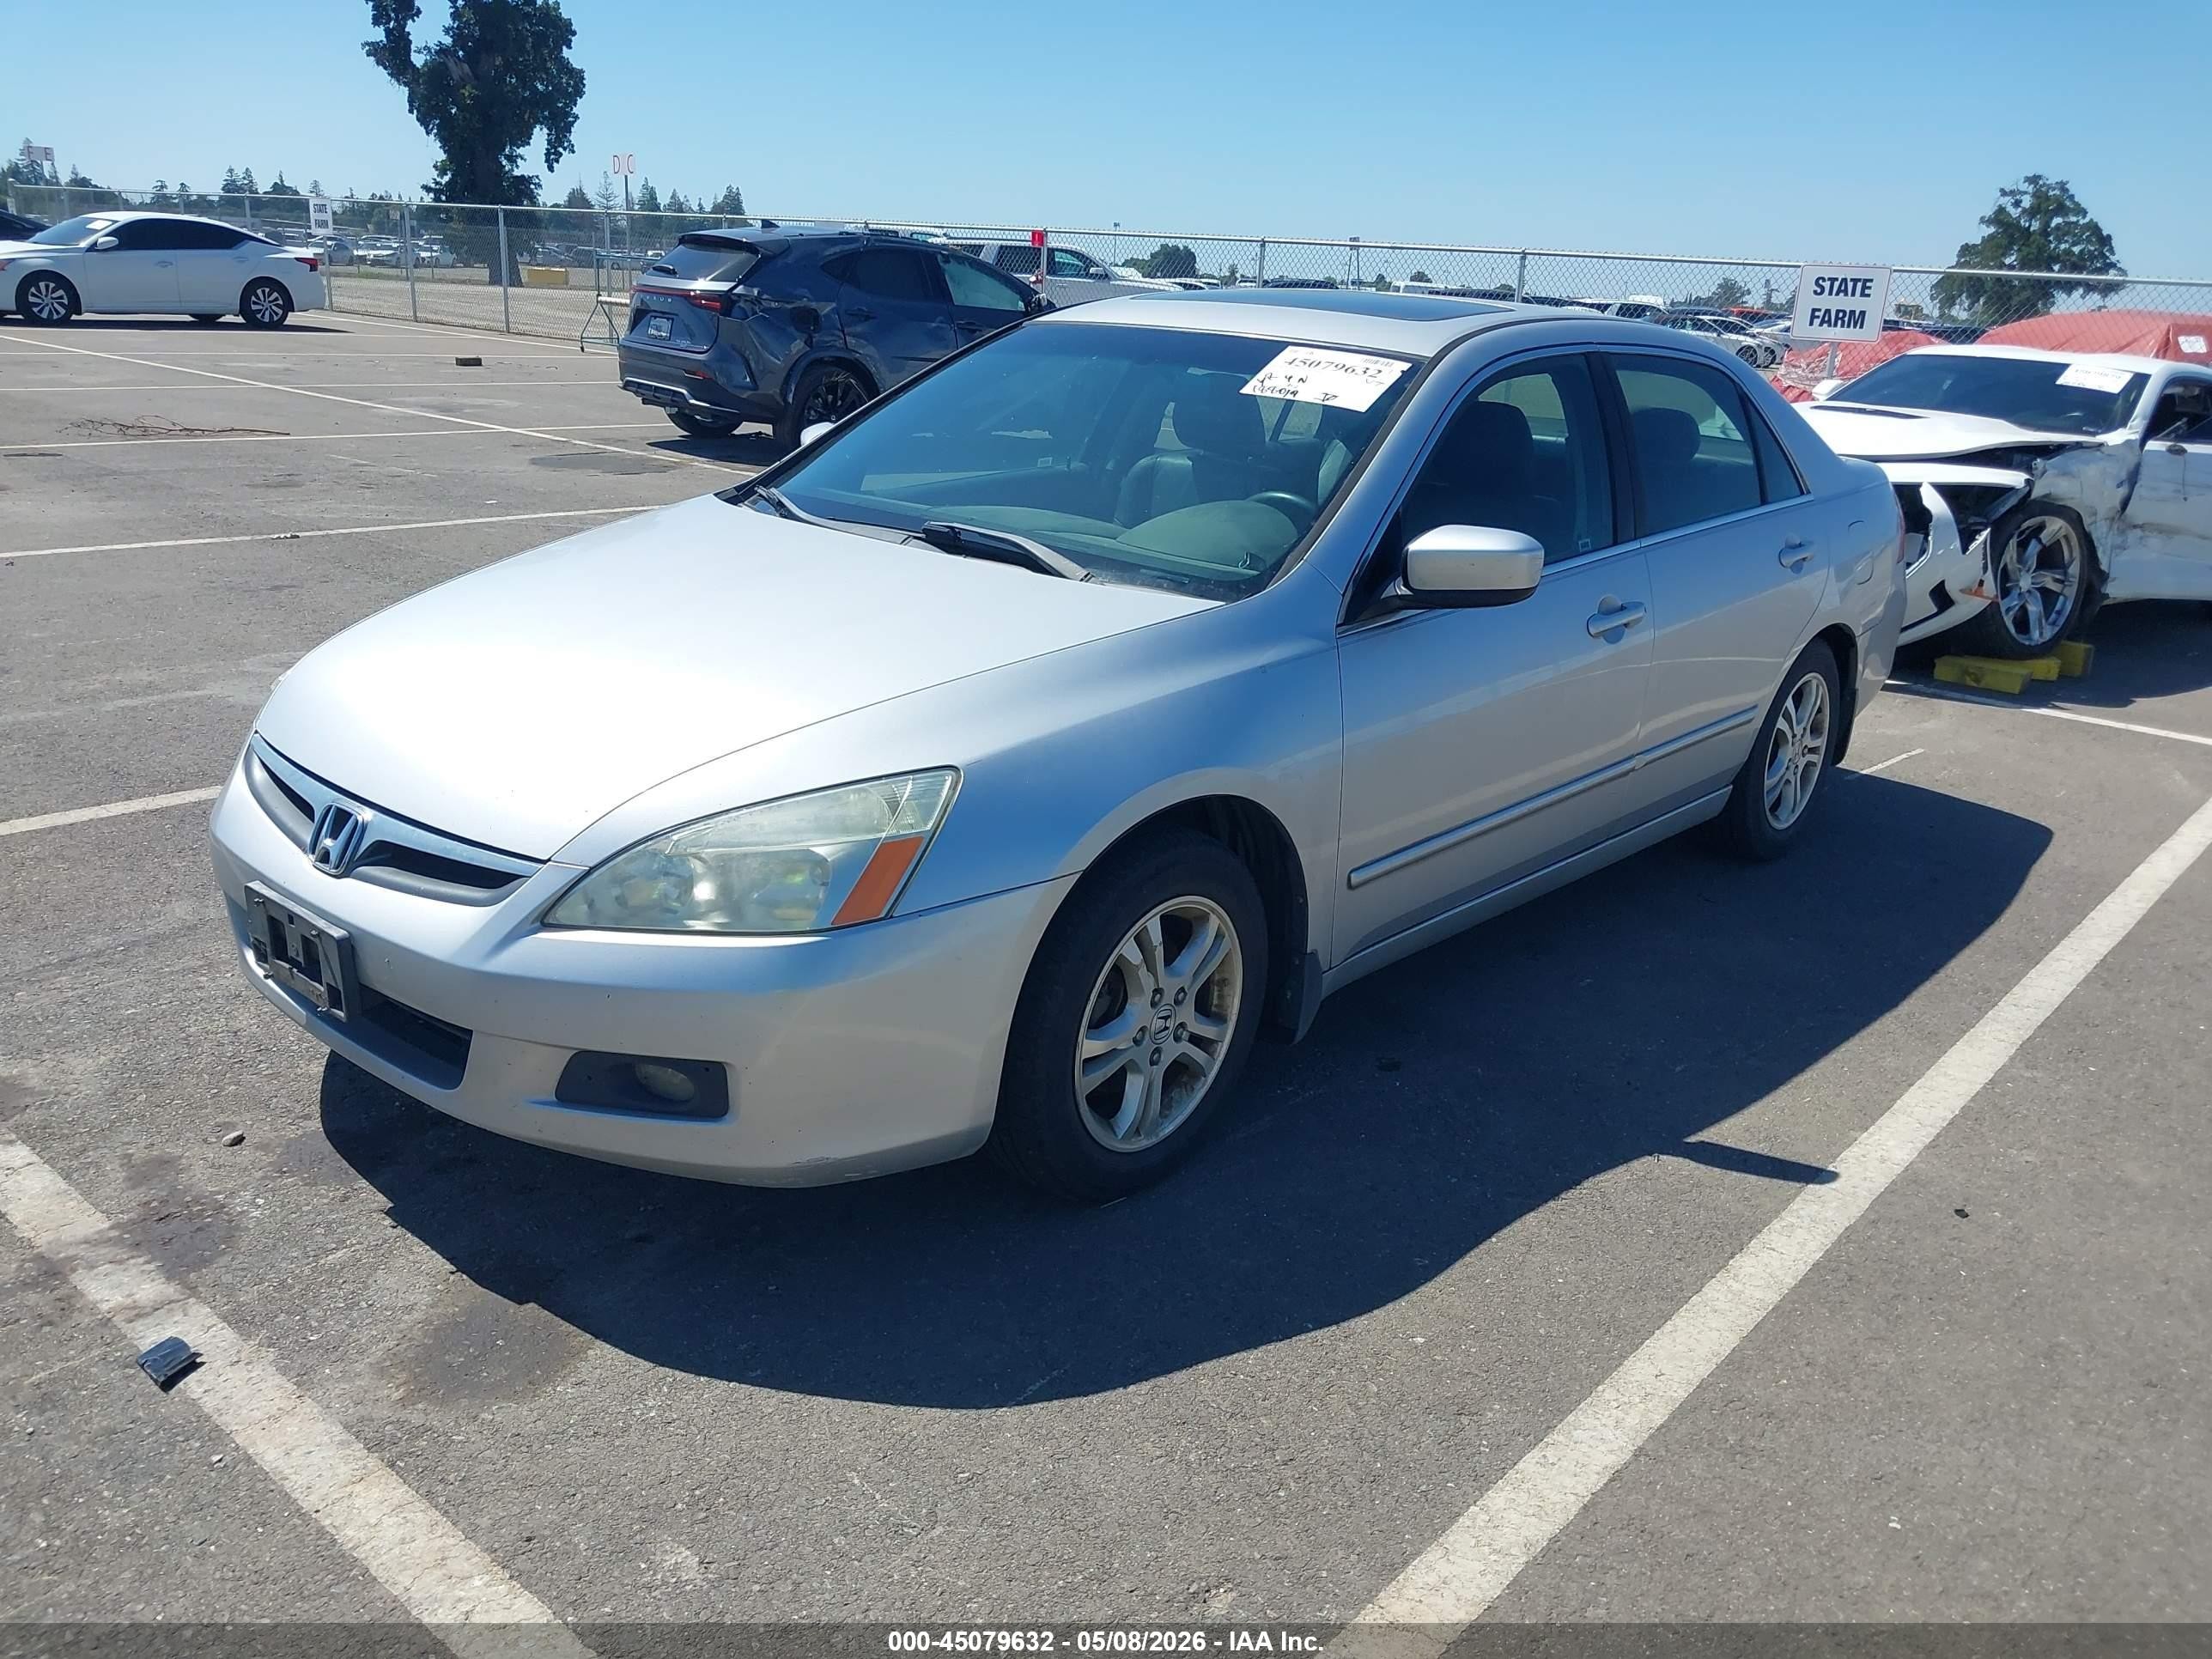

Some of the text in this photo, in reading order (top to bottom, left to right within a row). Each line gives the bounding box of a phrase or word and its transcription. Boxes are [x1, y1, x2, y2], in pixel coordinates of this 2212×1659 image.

[45, 147, 53, 161] E
[612, 154, 635, 174] D C
[313, 203, 328, 214] STATE
[314, 219, 330, 229] FARM
[1813, 276, 1874, 298] STATE
[1808, 307, 1867, 330] FARM
[1284, 357, 1382, 380] 45079632
